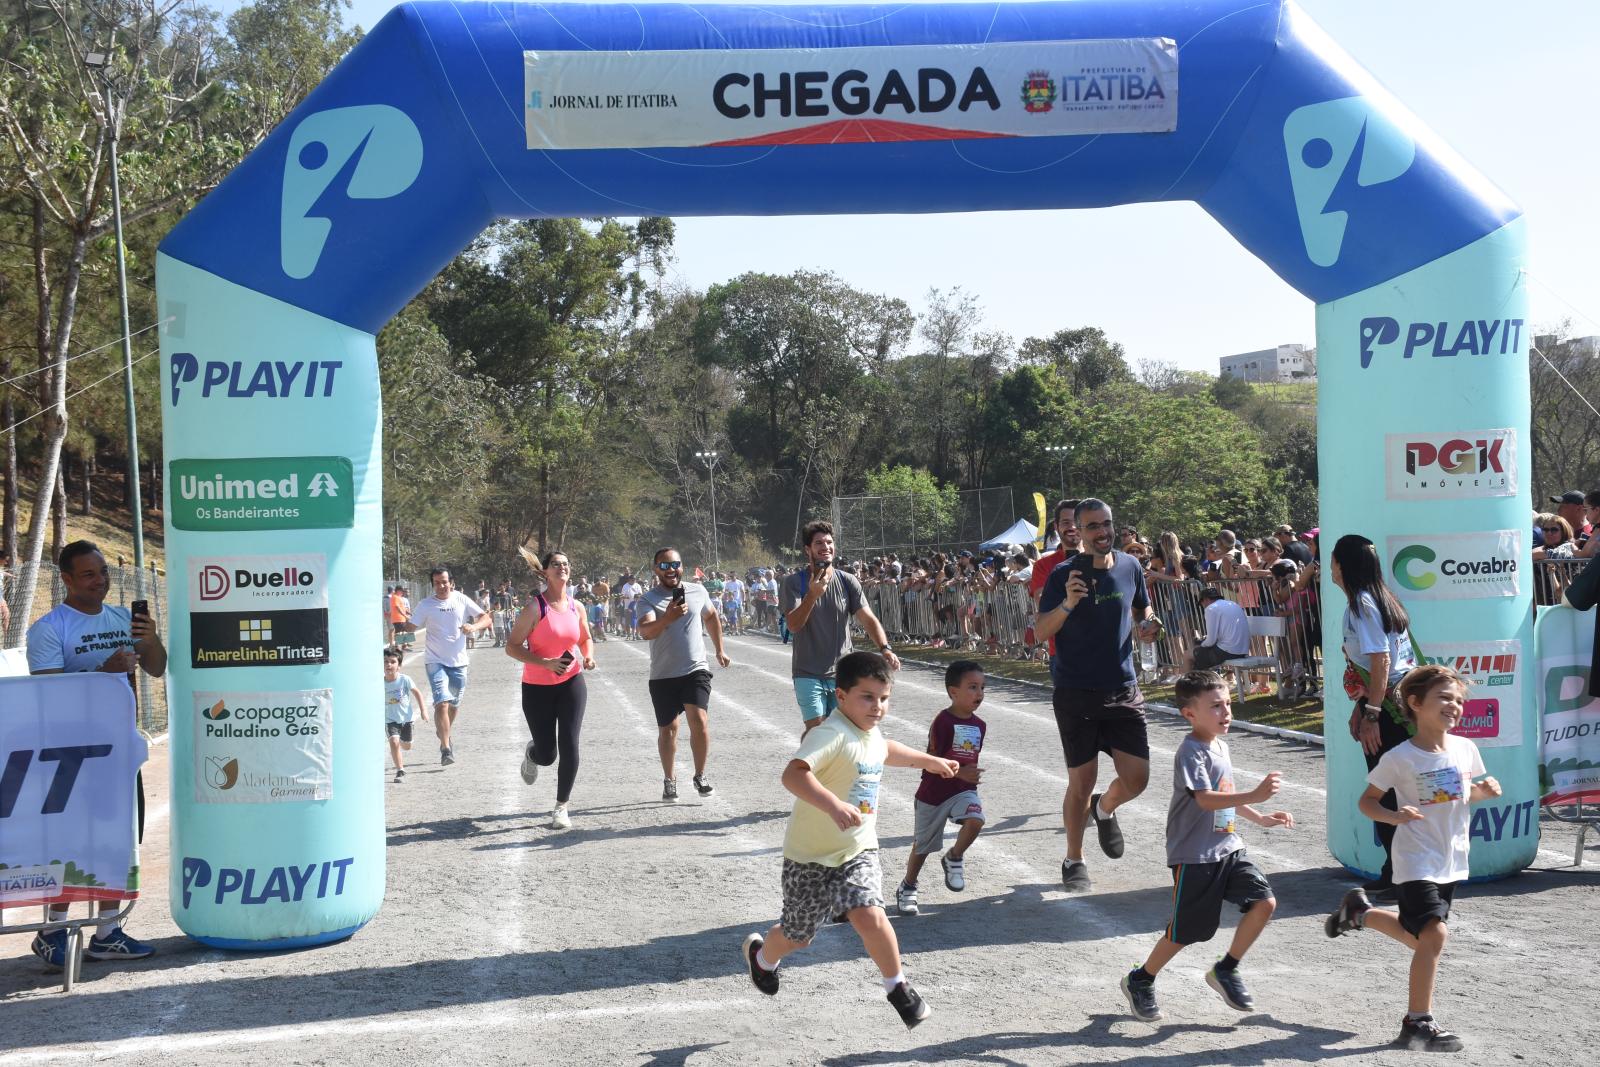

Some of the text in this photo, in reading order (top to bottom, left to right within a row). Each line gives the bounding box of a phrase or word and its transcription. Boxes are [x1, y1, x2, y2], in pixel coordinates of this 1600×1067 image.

[712, 66, 1001, 119] CHEGADA
[1062, 74, 1165, 102] ITATIBA
[549, 94, 678, 109] JORNAL DE ITATIBA
[1403, 319, 1524, 359] PLAYIT
[202, 360, 343, 398] PLAYIT
[1406, 439, 1504, 476] PGK
[180, 473, 298, 500] Unimed
[1405, 478, 1505, 488] IMÓVEIS
[196, 506, 300, 519] Os Bandeirantes
[1440, 556, 1517, 576] Covabra
[235, 567, 314, 588] Duello
[97, 630, 127, 640] PROVA
[74, 646, 89, 655] DE
[234, 705, 318, 724] copagaz
[206, 722, 319, 738] Palladino Gás
[1545, 723, 1590, 745] TUDO
[243, 771, 305, 787] Madame
[215, 857, 354, 905] PLAYIT
